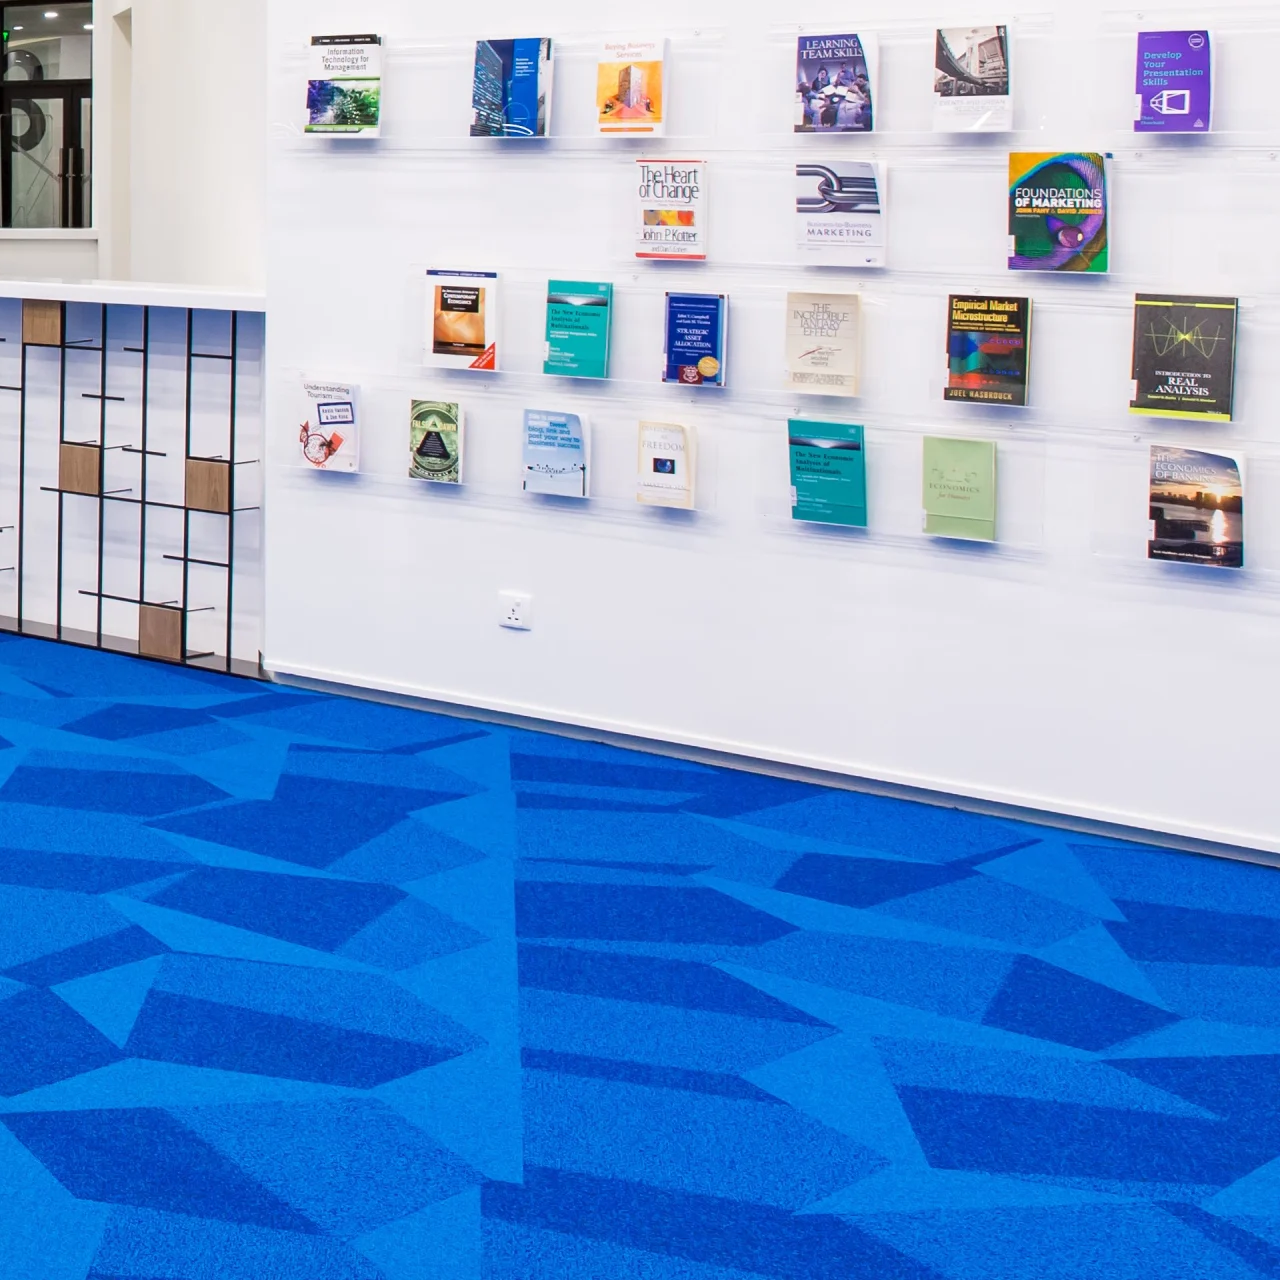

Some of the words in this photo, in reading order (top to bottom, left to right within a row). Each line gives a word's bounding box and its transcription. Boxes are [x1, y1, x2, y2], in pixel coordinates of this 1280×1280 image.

[806, 38, 858, 50] LEARNING
[327, 48, 364, 56] Information
[800, 49, 832, 60] TEAM
[833, 47, 863, 58] SKILLS
[1143, 51, 1182, 61] Develop
[322, 56, 358, 64] Technology
[1143, 61, 1166, 69] Your
[324, 64, 367, 72] Management
[1143, 68, 1204, 77] Presentation
[1142, 78, 1169, 86] Skills
[640, 165, 662, 184] The
[663, 165, 698, 185] Heart
[639, 180, 651, 199] of
[653, 180, 700, 204] Change
[1015, 187, 1102, 199] FOUNDATIONS
[1014, 197, 1030, 207] OF
[1031, 198, 1102, 208] MARKETING
[641, 228, 662, 241] John
[671, 228, 698, 242] Kotter
[806, 228, 872, 237] MARKETING
[811, 302, 831, 312] THE
[952, 298, 988, 311] Empirical
[989, 300, 1018, 311] Market
[793, 310, 849, 322] INCREDIBLE
[952, 309, 1008, 322] Microstructure
[550, 322, 589, 330] Multinationals
[676, 327, 710, 335] STRATEGIC
[803, 328, 838, 337] EFFECT
[673, 340, 711, 348] ALLOCATION
[1154, 370, 1201, 378] INTRODUCTION
[1167, 376, 1198, 387] REAL
[303, 383, 350, 394] Understanding
[1155, 385, 1209, 396] ANALYSIS
[306, 391, 333, 399] Tourism
[949, 389, 966, 397] JOEL
[969, 390, 1013, 400] HASBROUCK
[549, 421, 569, 429] tweet,
[527, 439, 556, 447] business
[557, 442, 581, 450] success
[642, 440, 686, 451] FREEDOM
[795, 459, 821, 467] Analysis
[823, 454, 855, 462] Economic
[795, 466, 842, 475] Multinationals
[1155, 461, 1217, 475] ECONOMICS
[1154, 470, 1171, 479] OF
[929, 482, 981, 493] ECONOMICS
